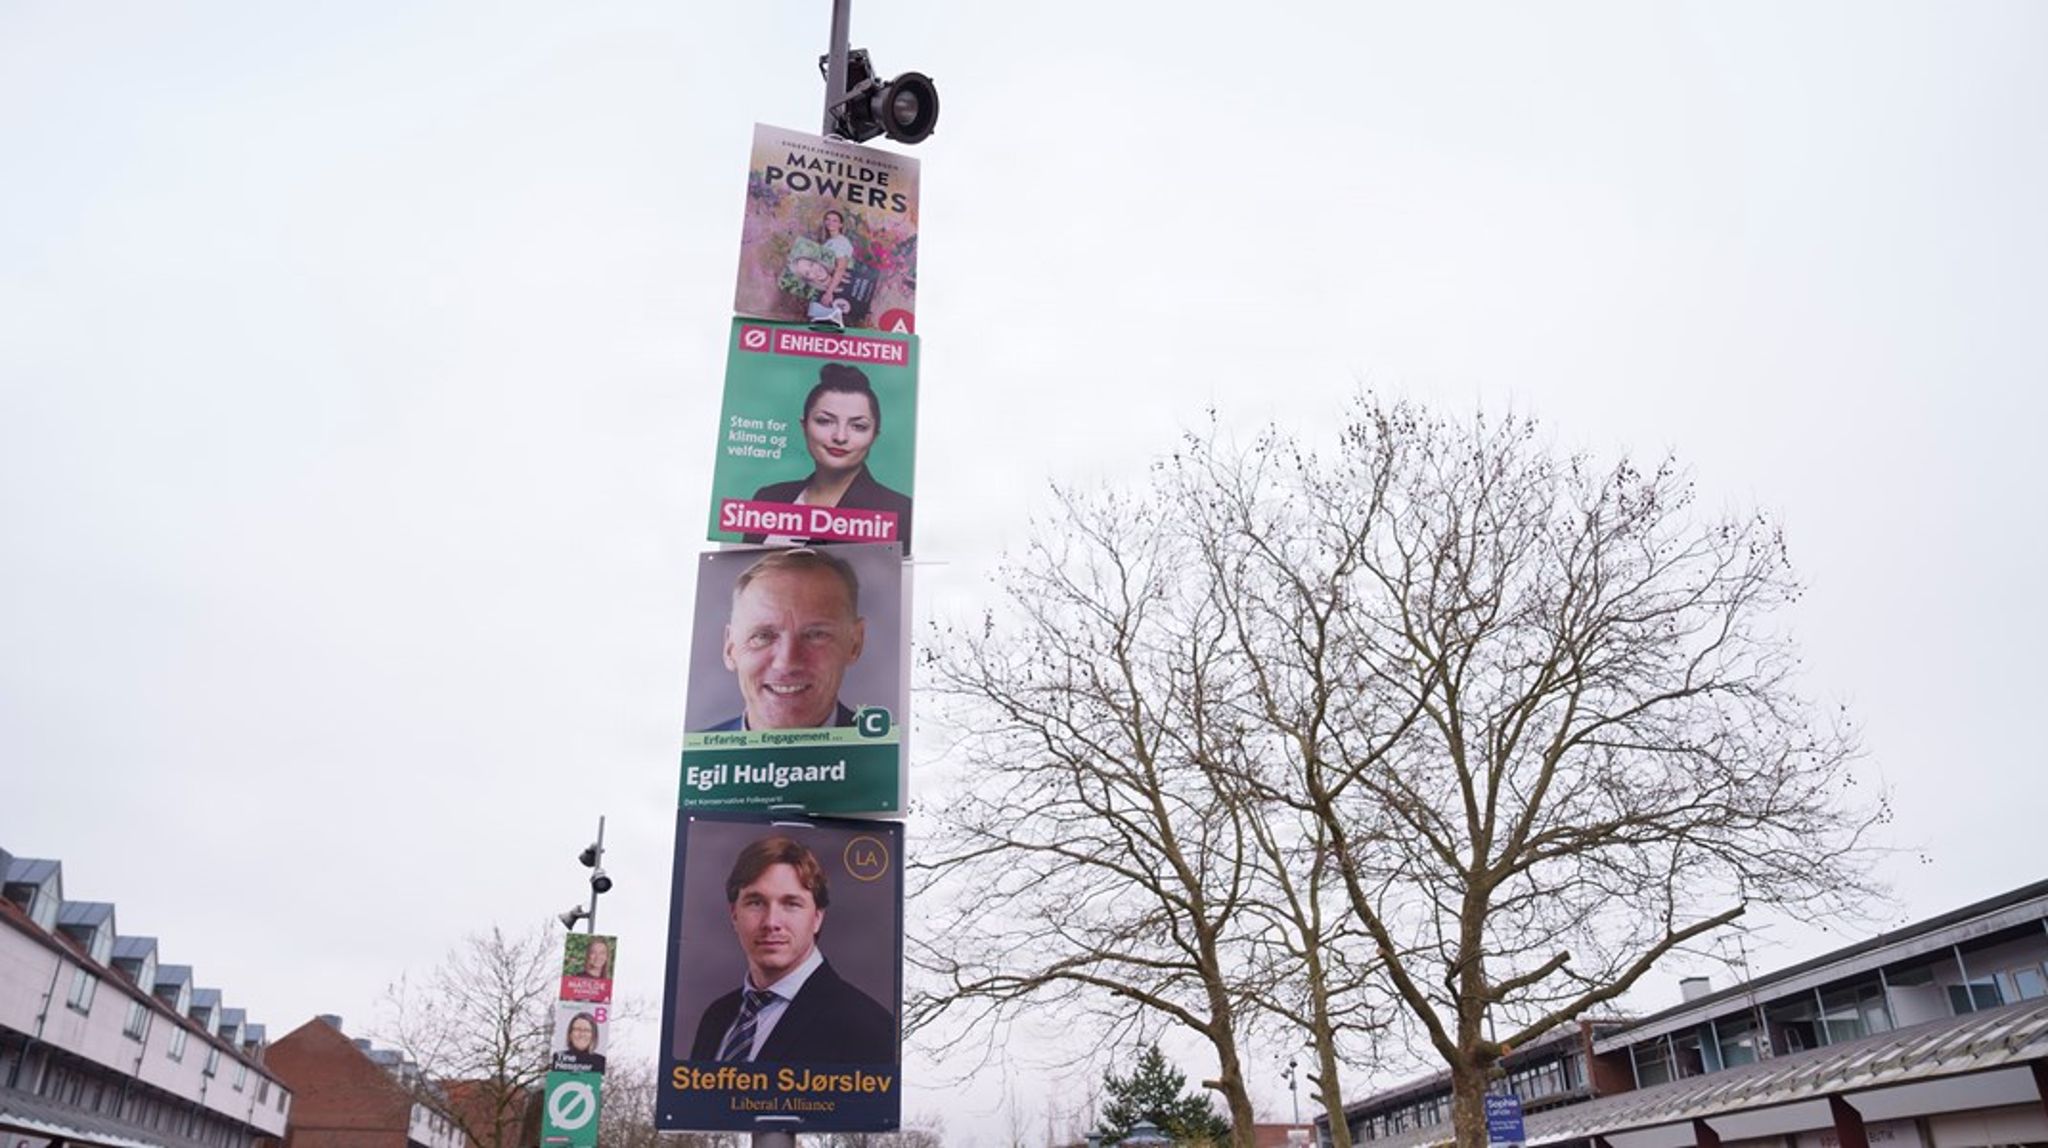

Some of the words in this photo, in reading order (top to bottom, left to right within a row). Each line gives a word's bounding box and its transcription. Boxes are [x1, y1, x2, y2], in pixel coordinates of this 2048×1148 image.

[787, 152, 889, 187] MATILDE
[765, 165, 908, 213] POWERS
[780, 333, 903, 361] ENHEDSLISTEN
[730, 415, 763, 429] Stem
[767, 419, 788, 431] for
[728, 430, 767, 444] klima
[770, 436, 788, 448] og
[727, 445, 781, 459] velfærd
[723, 502, 803, 531] Sinem
[810, 509, 894, 538] Demir
[865, 713, 882, 732] C
[703, 734, 747, 746] Erfaring
[761, 731, 830, 745] Engagement
[686, 764, 727, 790] Egil
[734, 760, 846, 788] Hulgaard
[856, 849, 878, 866] LA
[594, 1007, 607, 1023] B
[672, 1066, 768, 1090] Steffen
[777, 1067, 892, 1093] SJørslev
[730, 1097, 778, 1111] Liberal
[782, 1097, 835, 1112] Alliance
